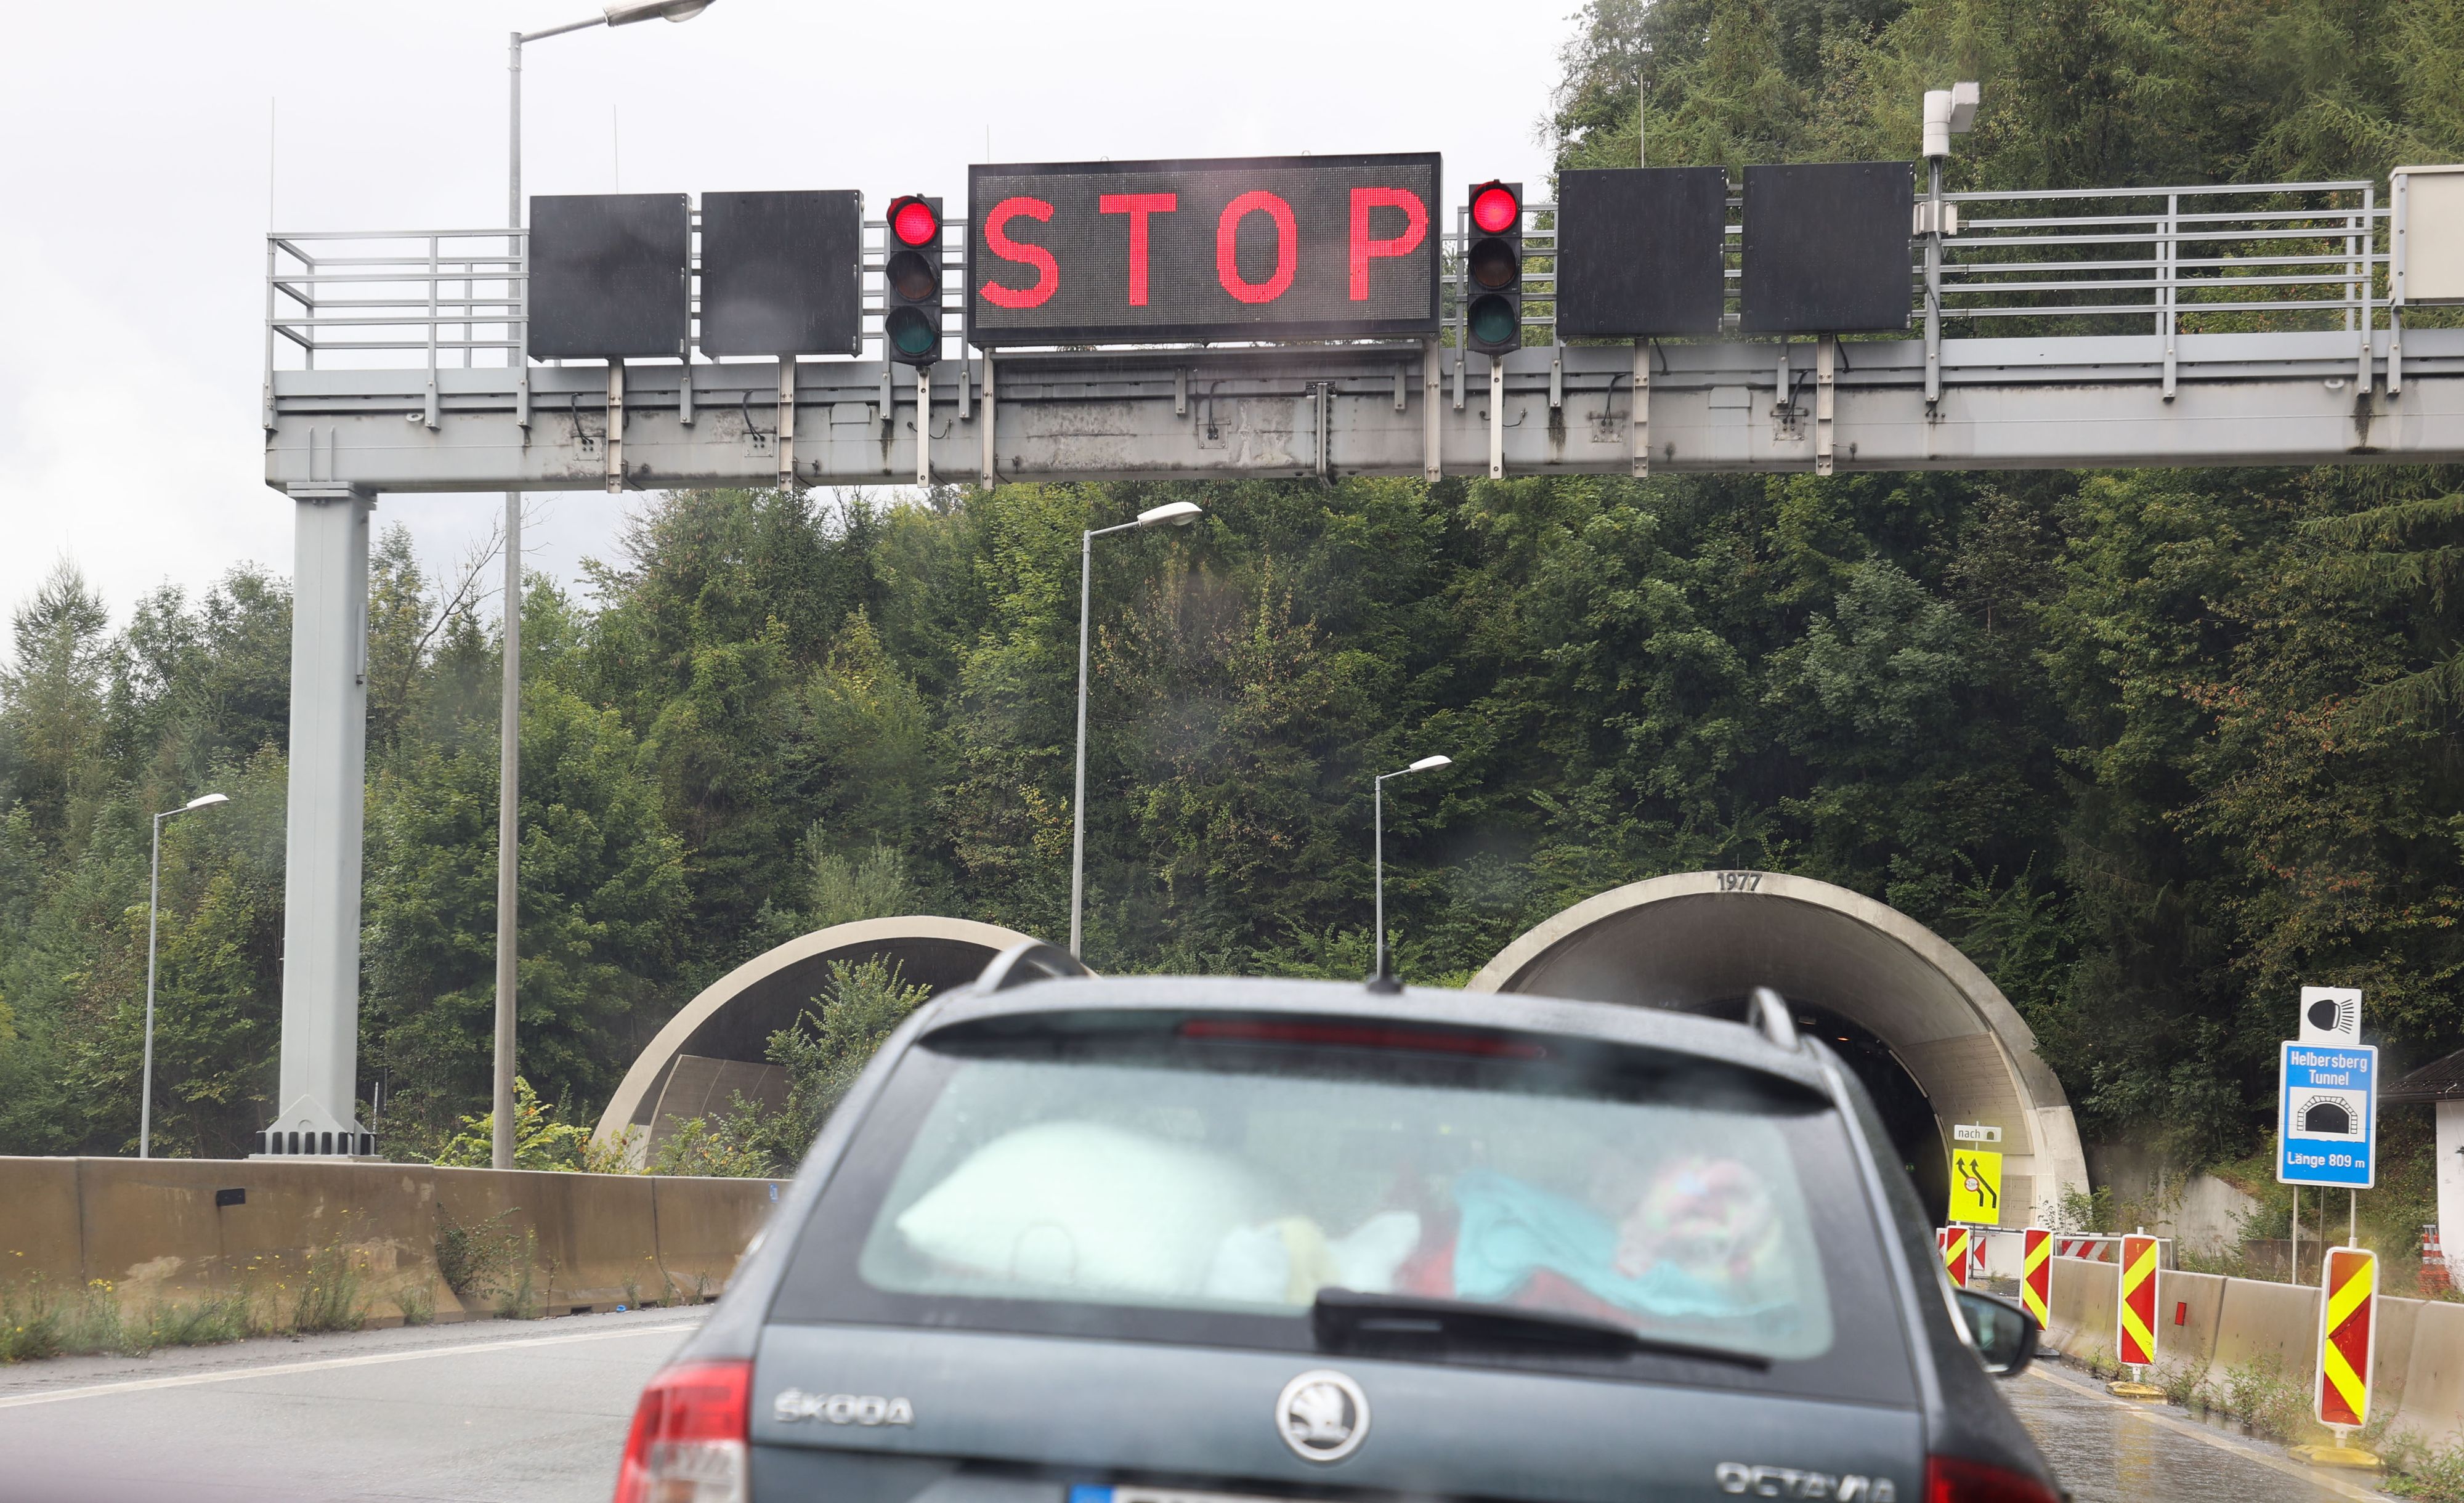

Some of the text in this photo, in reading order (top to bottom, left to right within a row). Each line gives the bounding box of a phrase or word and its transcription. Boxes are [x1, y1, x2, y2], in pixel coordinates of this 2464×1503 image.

[979, 187, 1429, 308] STOP
[1717, 872, 1763, 891] 1977
[2290, 1050, 2368, 1073] Helbersberg
[2308, 1069, 2349, 1086] Tunnel
[1958, 1128, 1980, 1139] nach
[2287, 1151, 2365, 1169] Länge 809 m
